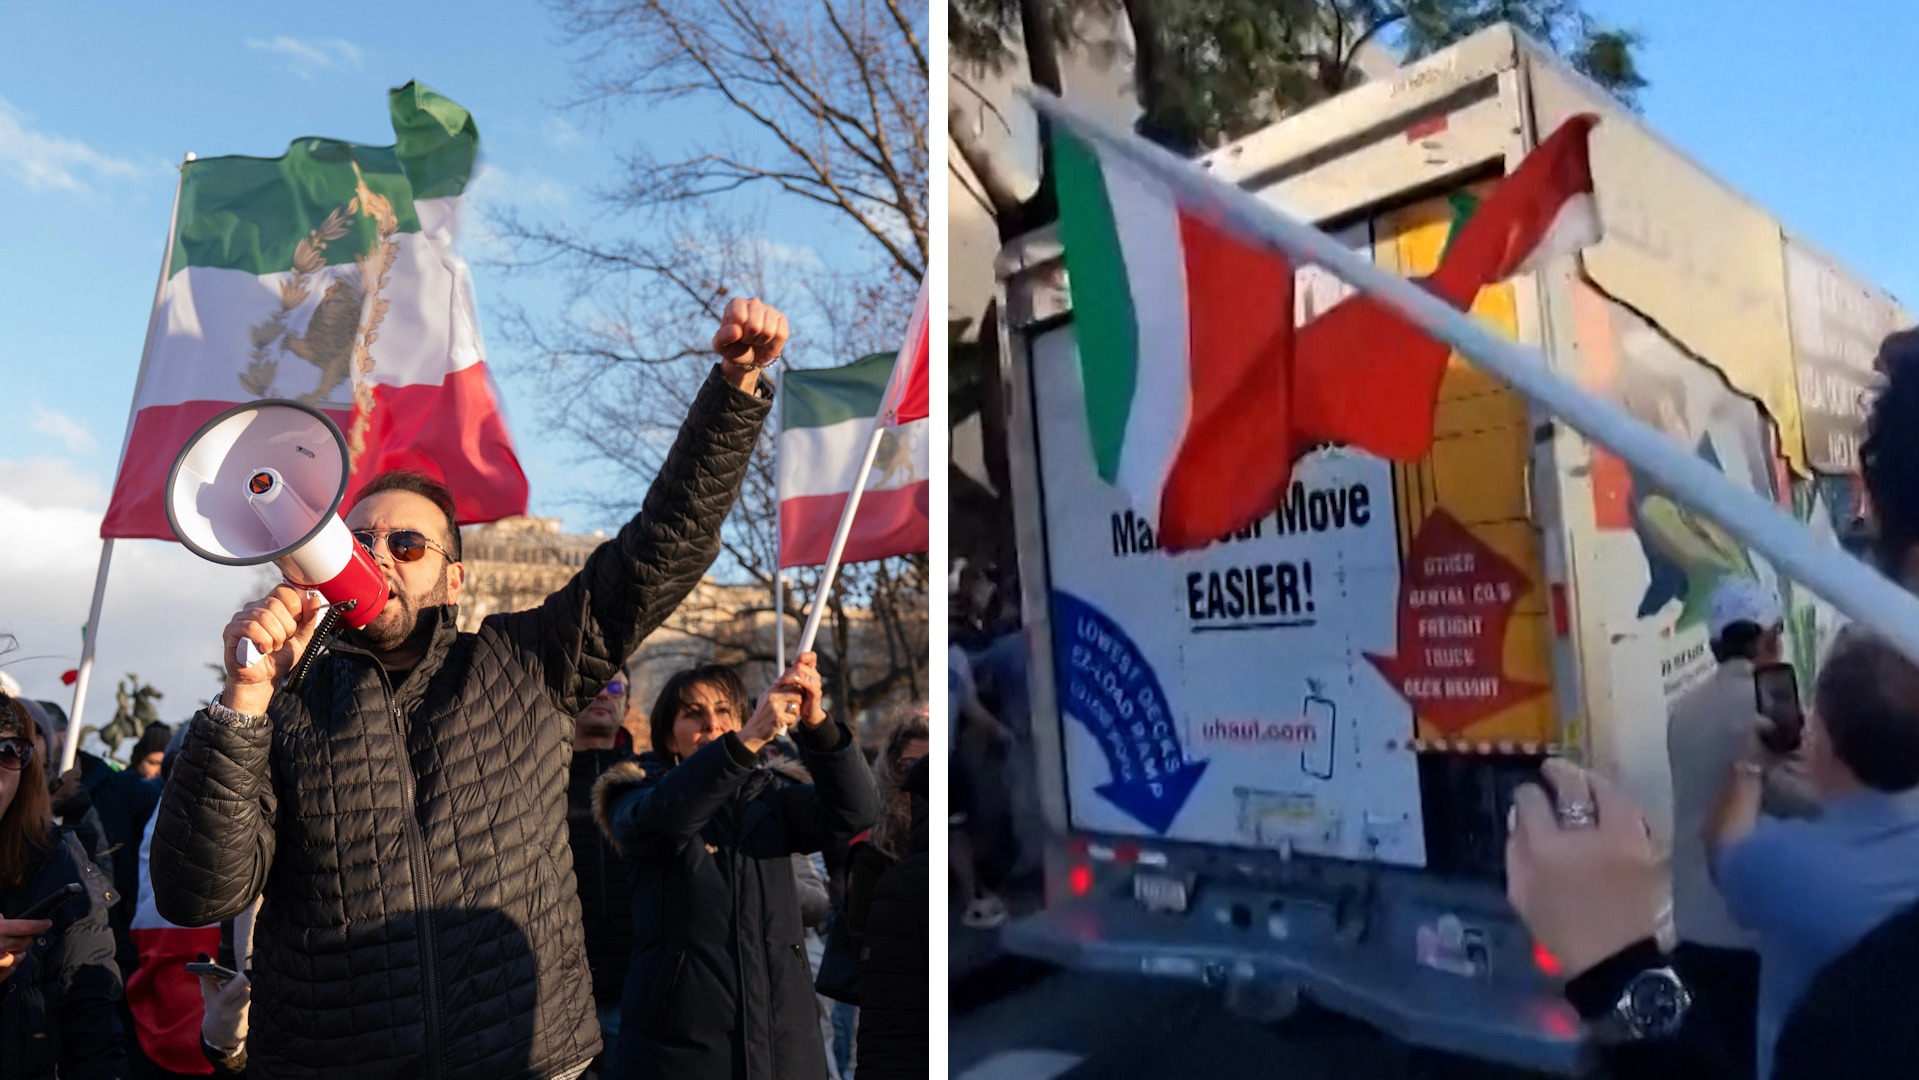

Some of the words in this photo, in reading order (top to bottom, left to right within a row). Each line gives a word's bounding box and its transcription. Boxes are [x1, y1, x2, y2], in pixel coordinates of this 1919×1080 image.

[1111, 508, 1161, 557] Ma
[1277, 480, 1371, 536] Move
[1423, 553, 1476, 577] OTHER
[1186, 559, 1315, 620] EASIER!
[1418, 616, 1483, 637] FREIGHT
[1424, 648, 1475, 667] TRUCK
[1077, 615, 1142, 682] LOWEST
[1138, 686, 1182, 774] DECKS
[1202, 718, 1317, 741] uhaul.com
